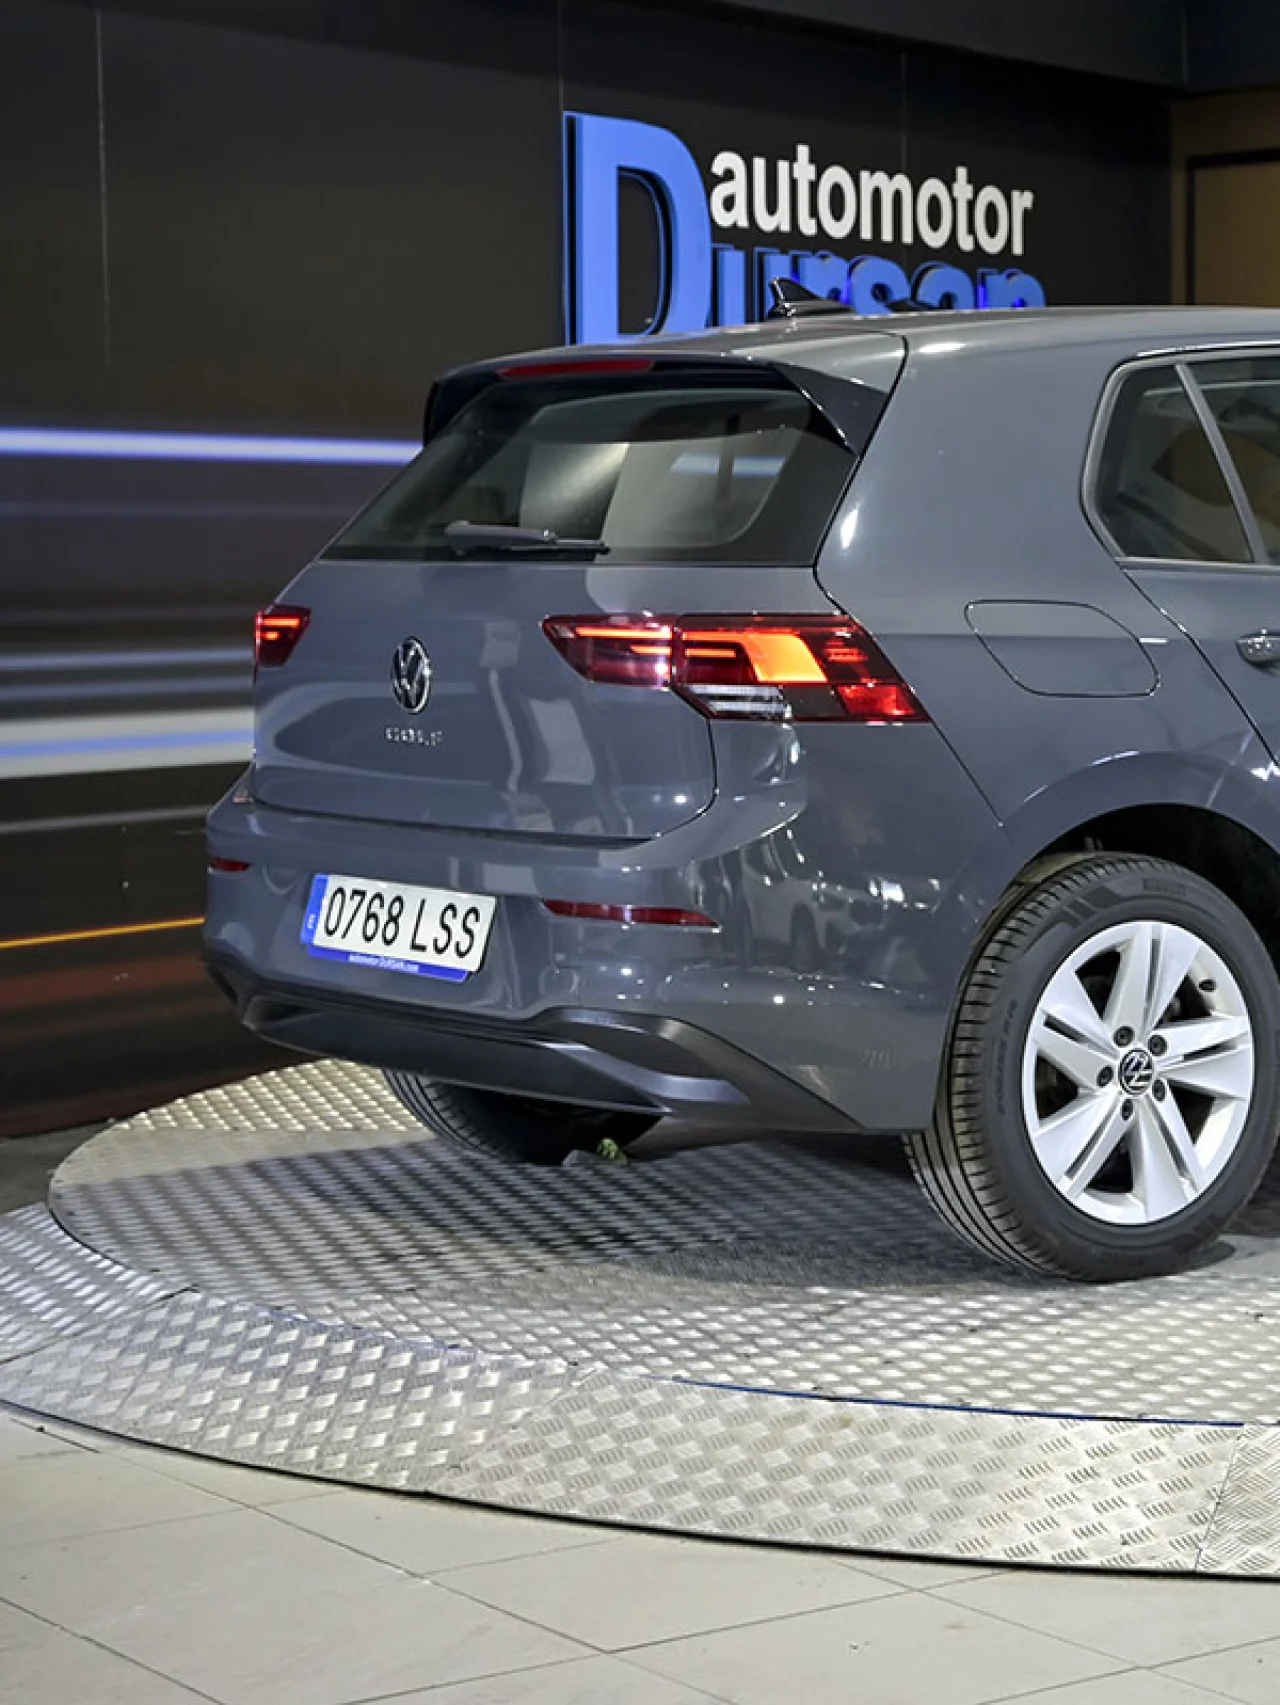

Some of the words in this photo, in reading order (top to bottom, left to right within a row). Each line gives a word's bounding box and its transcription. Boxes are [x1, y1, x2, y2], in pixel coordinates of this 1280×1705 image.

[710, 144, 1034, 255] automotor
[324, 887, 404, 946] 0768
[410, 898, 480, 958] LSS
